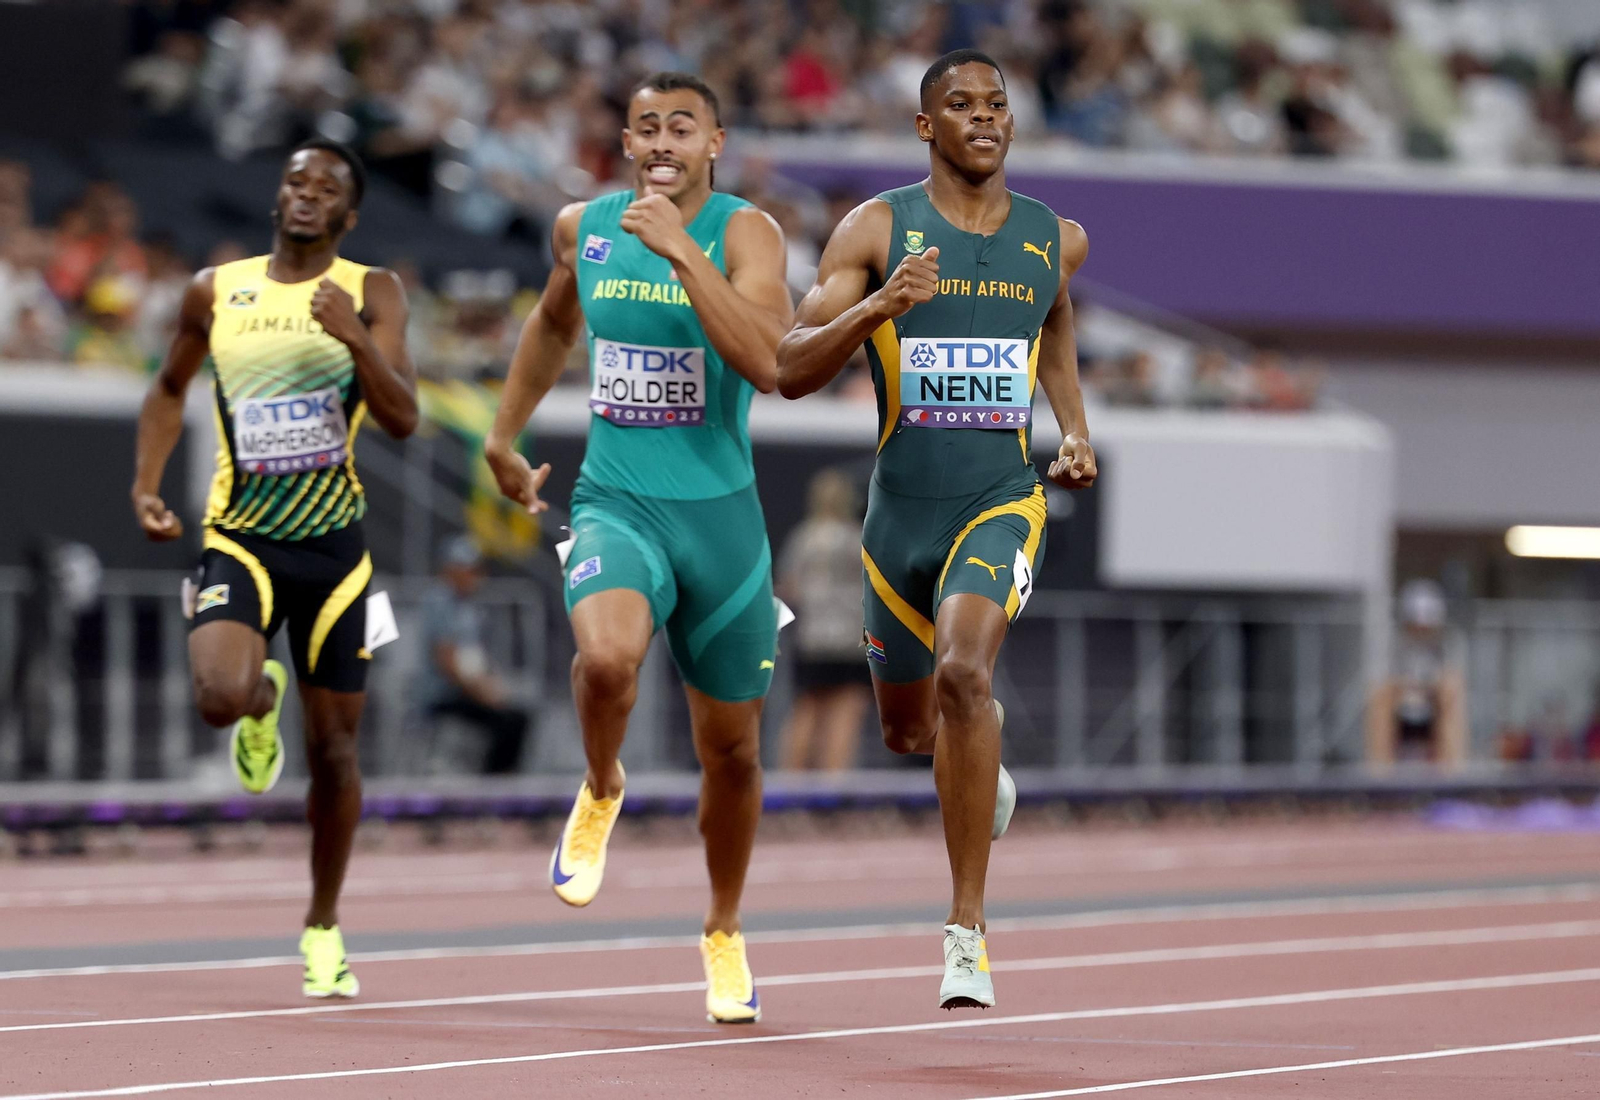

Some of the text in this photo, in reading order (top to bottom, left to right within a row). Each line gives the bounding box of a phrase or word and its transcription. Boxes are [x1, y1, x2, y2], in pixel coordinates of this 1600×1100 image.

[977, 280, 1034, 305] AFRICA
[234, 316, 325, 335] JAMAIC
[620, 347, 694, 374] TDK
[937, 343, 1019, 369] TDK
[599, 375, 698, 404] HOLDER
[920, 375, 1013, 402] NENE
[263, 394, 335, 423] TDK
